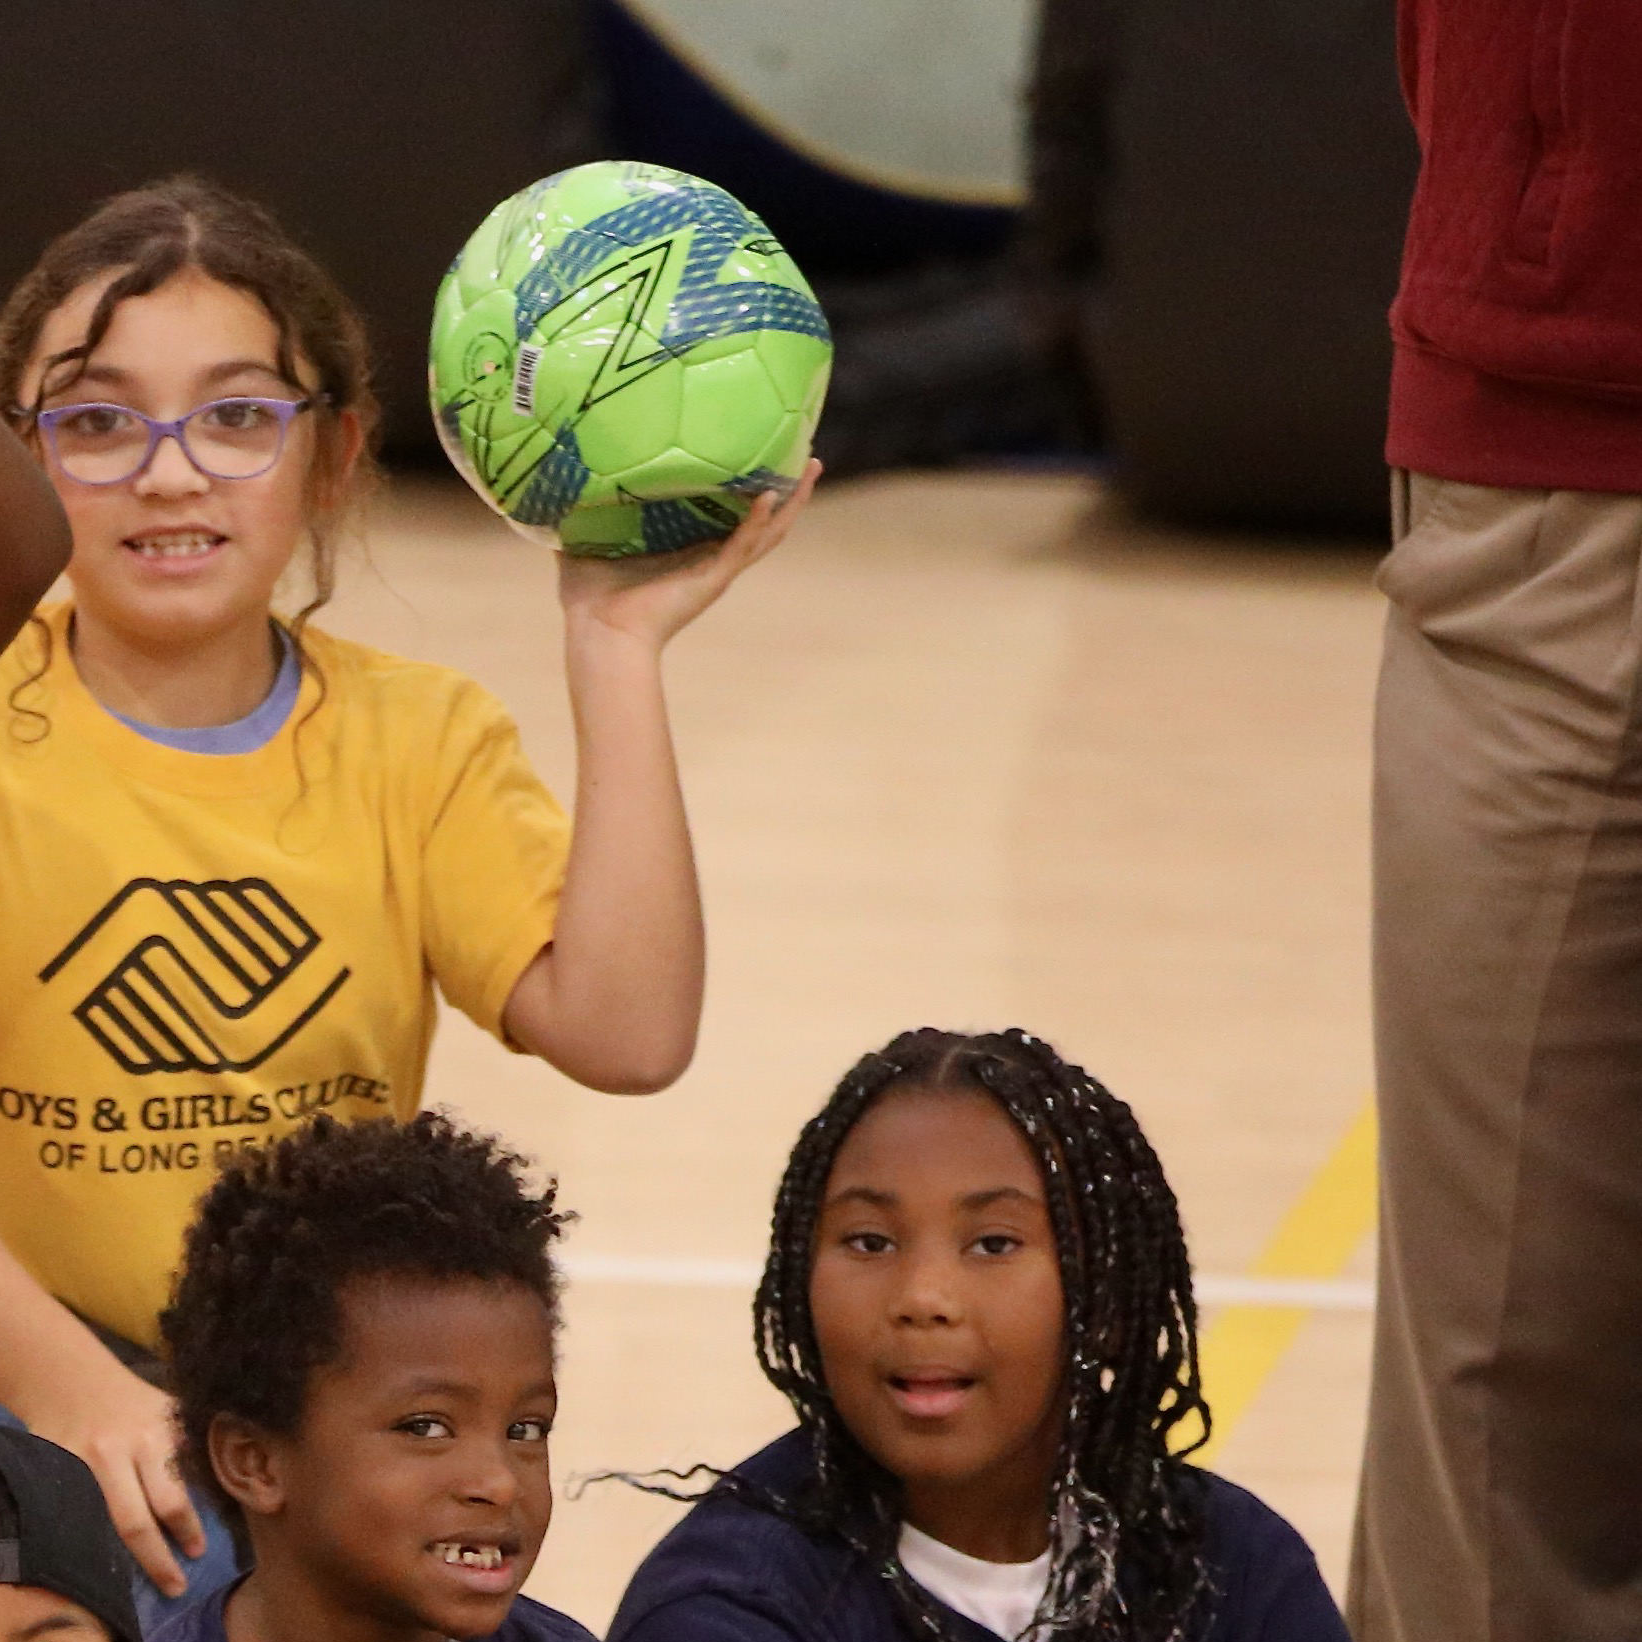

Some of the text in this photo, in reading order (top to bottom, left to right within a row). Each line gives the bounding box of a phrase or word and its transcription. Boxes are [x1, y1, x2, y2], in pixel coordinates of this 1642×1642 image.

[92, 1098, 127, 1132] &
[141, 1094, 271, 1131] GIRLS
[39, 1140, 86, 1170] OF
[99, 1141, 200, 1173] LONG
